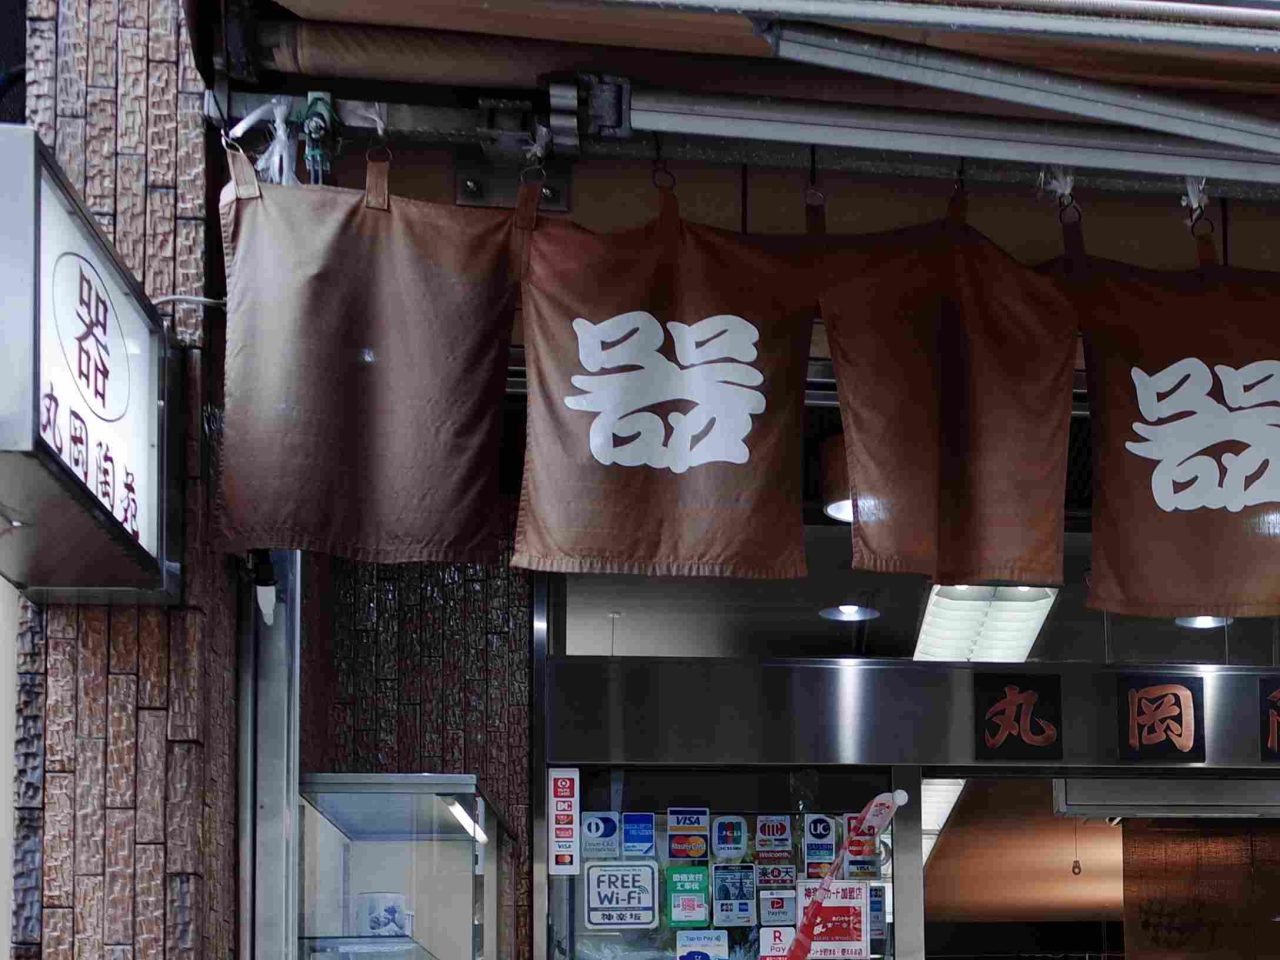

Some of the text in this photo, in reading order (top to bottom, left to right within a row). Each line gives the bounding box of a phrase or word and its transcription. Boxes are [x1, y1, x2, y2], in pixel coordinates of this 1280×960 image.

[74, 264, 110, 409] 器
[564, 311, 766, 474] 器
[676, 816, 701, 826] VISA
[810, 822, 830, 834] UC
[597, 873, 641, 889] FREE
[597, 890, 641, 905] Wi-Fi
[770, 945, 787, 953] Pay
